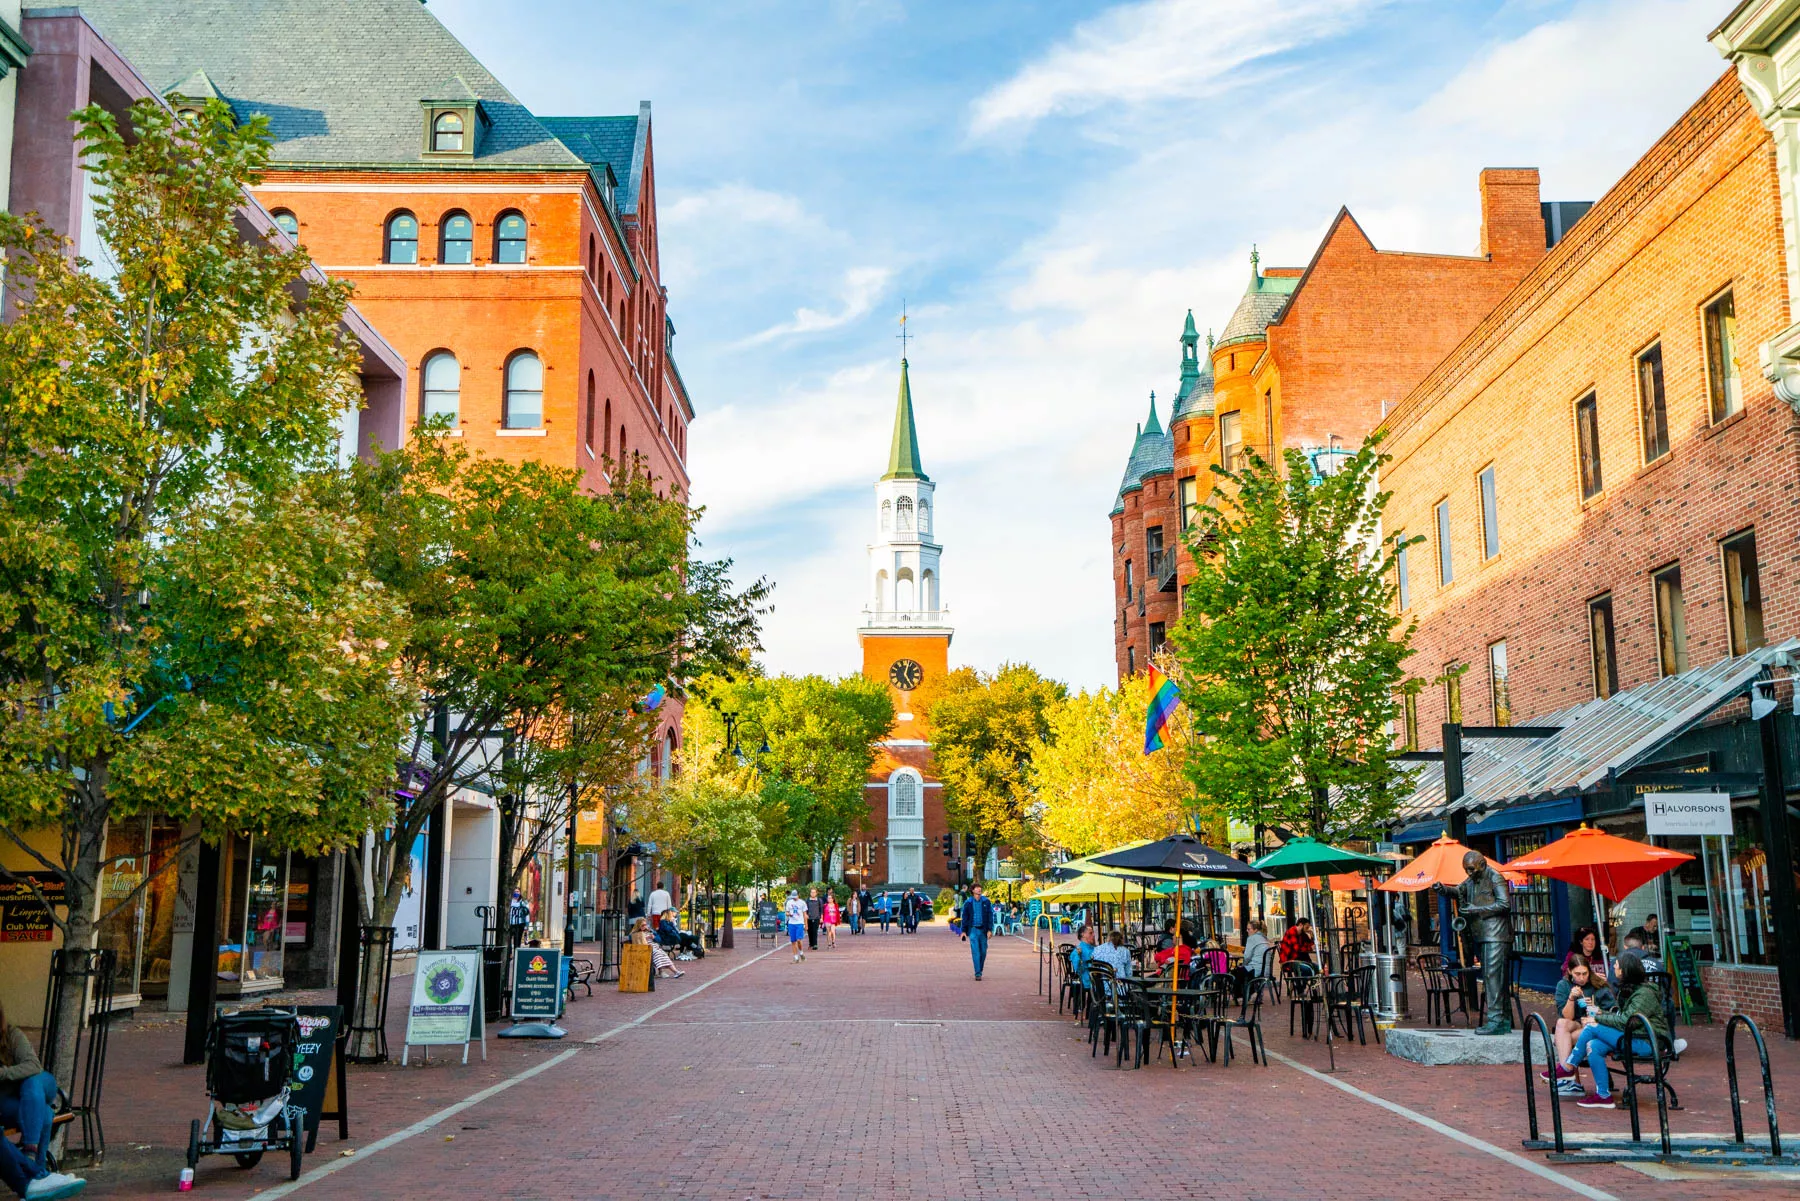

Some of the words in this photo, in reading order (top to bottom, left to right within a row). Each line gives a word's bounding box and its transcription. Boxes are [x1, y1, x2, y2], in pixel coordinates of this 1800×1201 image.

[1654, 803, 1725, 816] HALVORSON'S
[1182, 862, 1228, 870] GUINNESS
[26, 922, 49, 930] Wear
[8, 931, 47, 940] SALE
[296, 1043, 322, 1054] YEEZY
